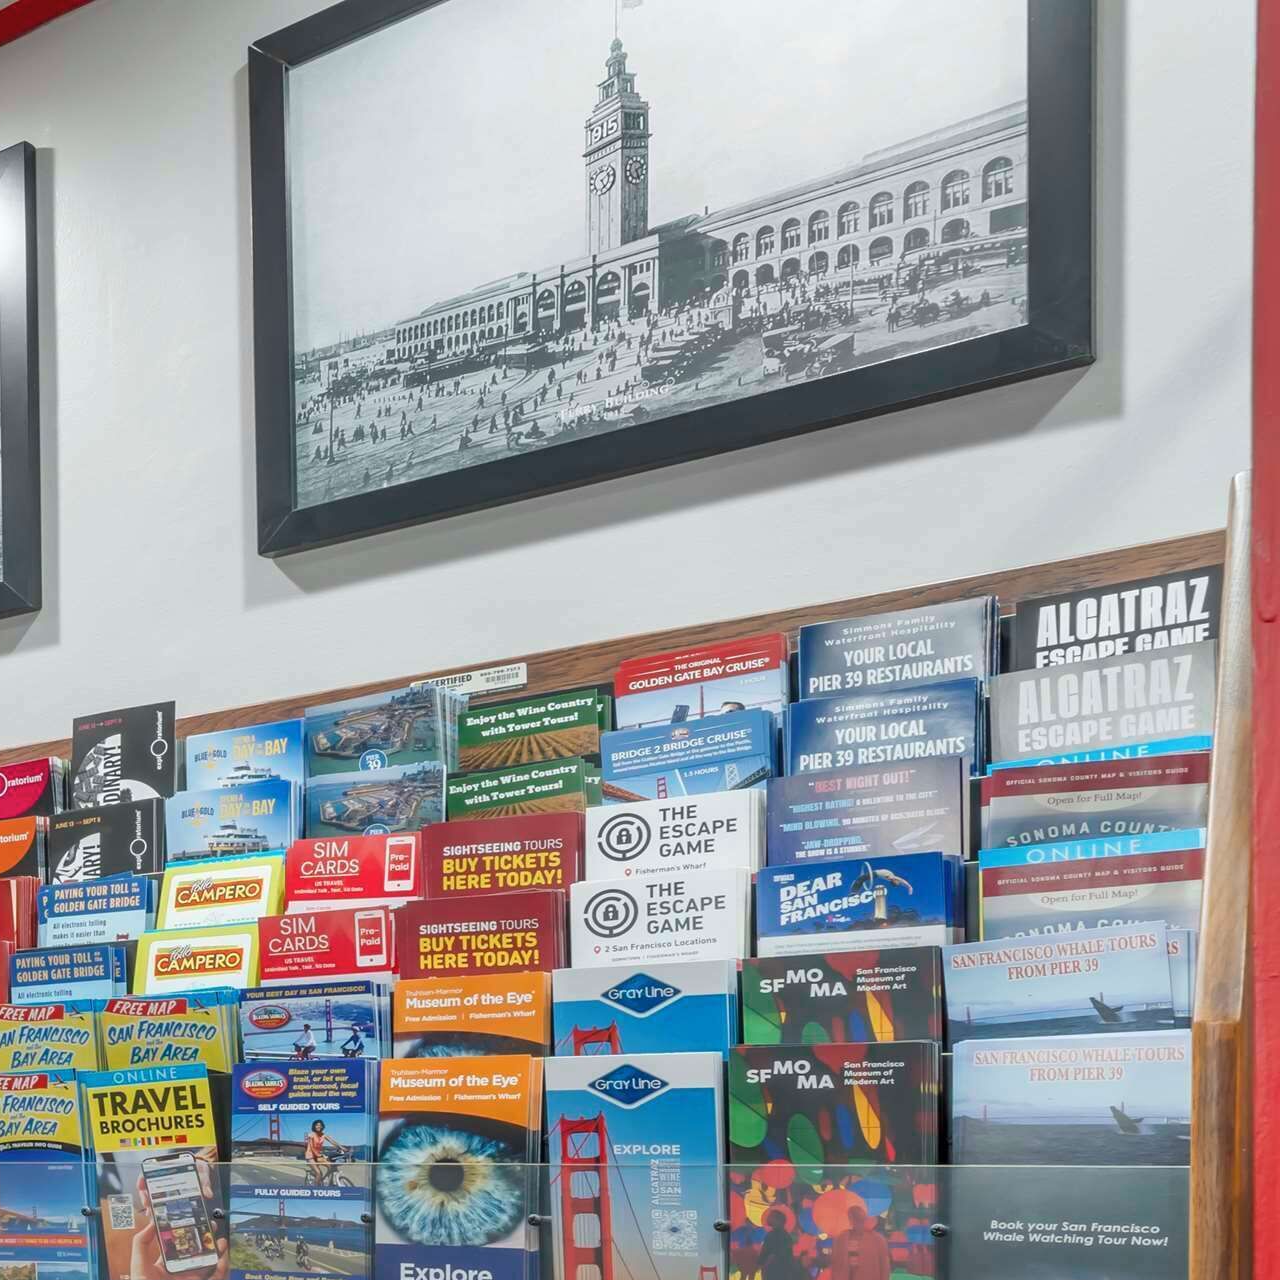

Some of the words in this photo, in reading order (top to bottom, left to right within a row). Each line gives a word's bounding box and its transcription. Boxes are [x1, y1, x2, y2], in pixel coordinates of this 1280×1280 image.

[588, 113, 618, 146] 1915
[605, 384, 669, 408] BUILDING
[824, 632, 886, 646] Waterfront
[891, 621, 956, 637] Hospitality
[842, 623, 892, 635] Simmons
[897, 615, 936, 625] Family
[844, 647, 885, 667] YOUR
[889, 639, 934, 660] LOCAL
[809, 676, 841, 693] PIER
[845, 672, 863, 687] 39
[867, 654, 973, 685] RESTAURANTS
[1018, 654, 1193, 725] ALCATRAZ
[466, 714, 496, 726] Enjoy
[498, 711, 515, 721] the
[516, 707, 546, 718] Wine
[547, 697, 593, 710] Country
[481, 726, 507, 737] with
[507, 719, 541, 732] Tower
[542, 712, 578, 725] Tours!
[1018, 716, 1112, 753] ESCAPE
[1120, 705, 1195, 738] GAME
[646, 881, 685, 897] THE
[780, 872, 842, 902] DEAR
[646, 895, 726, 916] ESCAPE
[780, 894, 818, 913] SAN
[280, 918, 316, 936] SIM
[419, 920, 497, 935] SIGHTSEEING
[499, 918, 539, 930] TOURS
[647, 915, 703, 934] GAME
[269, 934, 329, 953] CARDS
[419, 936, 454, 953] BUY
[463, 932, 538, 950] TICKETS
[604, 945, 610, 953] 2
[612, 943, 630, 952] San
[632, 940, 674, 951] Francisco
[676, 936, 717, 947] Locations
[952, 953, 978, 969] SAN
[979, 945, 1054, 967] FRANCISCO
[1056, 940, 1104, 960] WHALE
[1108, 934, 1158, 952] TOURS
[157, 953, 240, 972] CAMPERO
[419, 953, 468, 970] HERE
[471, 949, 540, 967] TODAY!
[1007, 963, 1047, 981] FROM
[1049, 961, 1080, 977] PIER
[1083, 959, 1100, 973] 39
[844, 1061, 860, 1069] San
[862, 1060, 905, 1069] Francisco
[844, 1070, 881, 1078] Museum
[883, 1069, 893, 1077] of
[13, 1075, 39, 1089] MAP
[113, 1067, 177, 1083] ONLINE
[844, 1078, 876, 1086] Modern
[878, 1077, 895, 1085] Art
[595, 1077, 629, 1095] Gray
[629, 1076, 662, 1092] Line
[2, 1095, 74, 1115] FRANCISCO
[93, 1085, 206, 1117] TRAVEL
[22, 1117, 58, 1136] AREA
[99, 1114, 205, 1135] BROCHURES
[613, 1144, 681, 1157] EXPLORE
[990, 1219, 1023, 1231] Book
[1027, 1221, 1058, 1232] your
[1061, 1221, 1086, 1232] San
[1091, 1223, 1160, 1234] Francisco
[983, 1232, 1024, 1242] Whale
[1027, 1232, 1093, 1247] Watching
[1097, 1235, 1128, 1246] Tour
[1131, 1236, 1169, 1247] Now!
